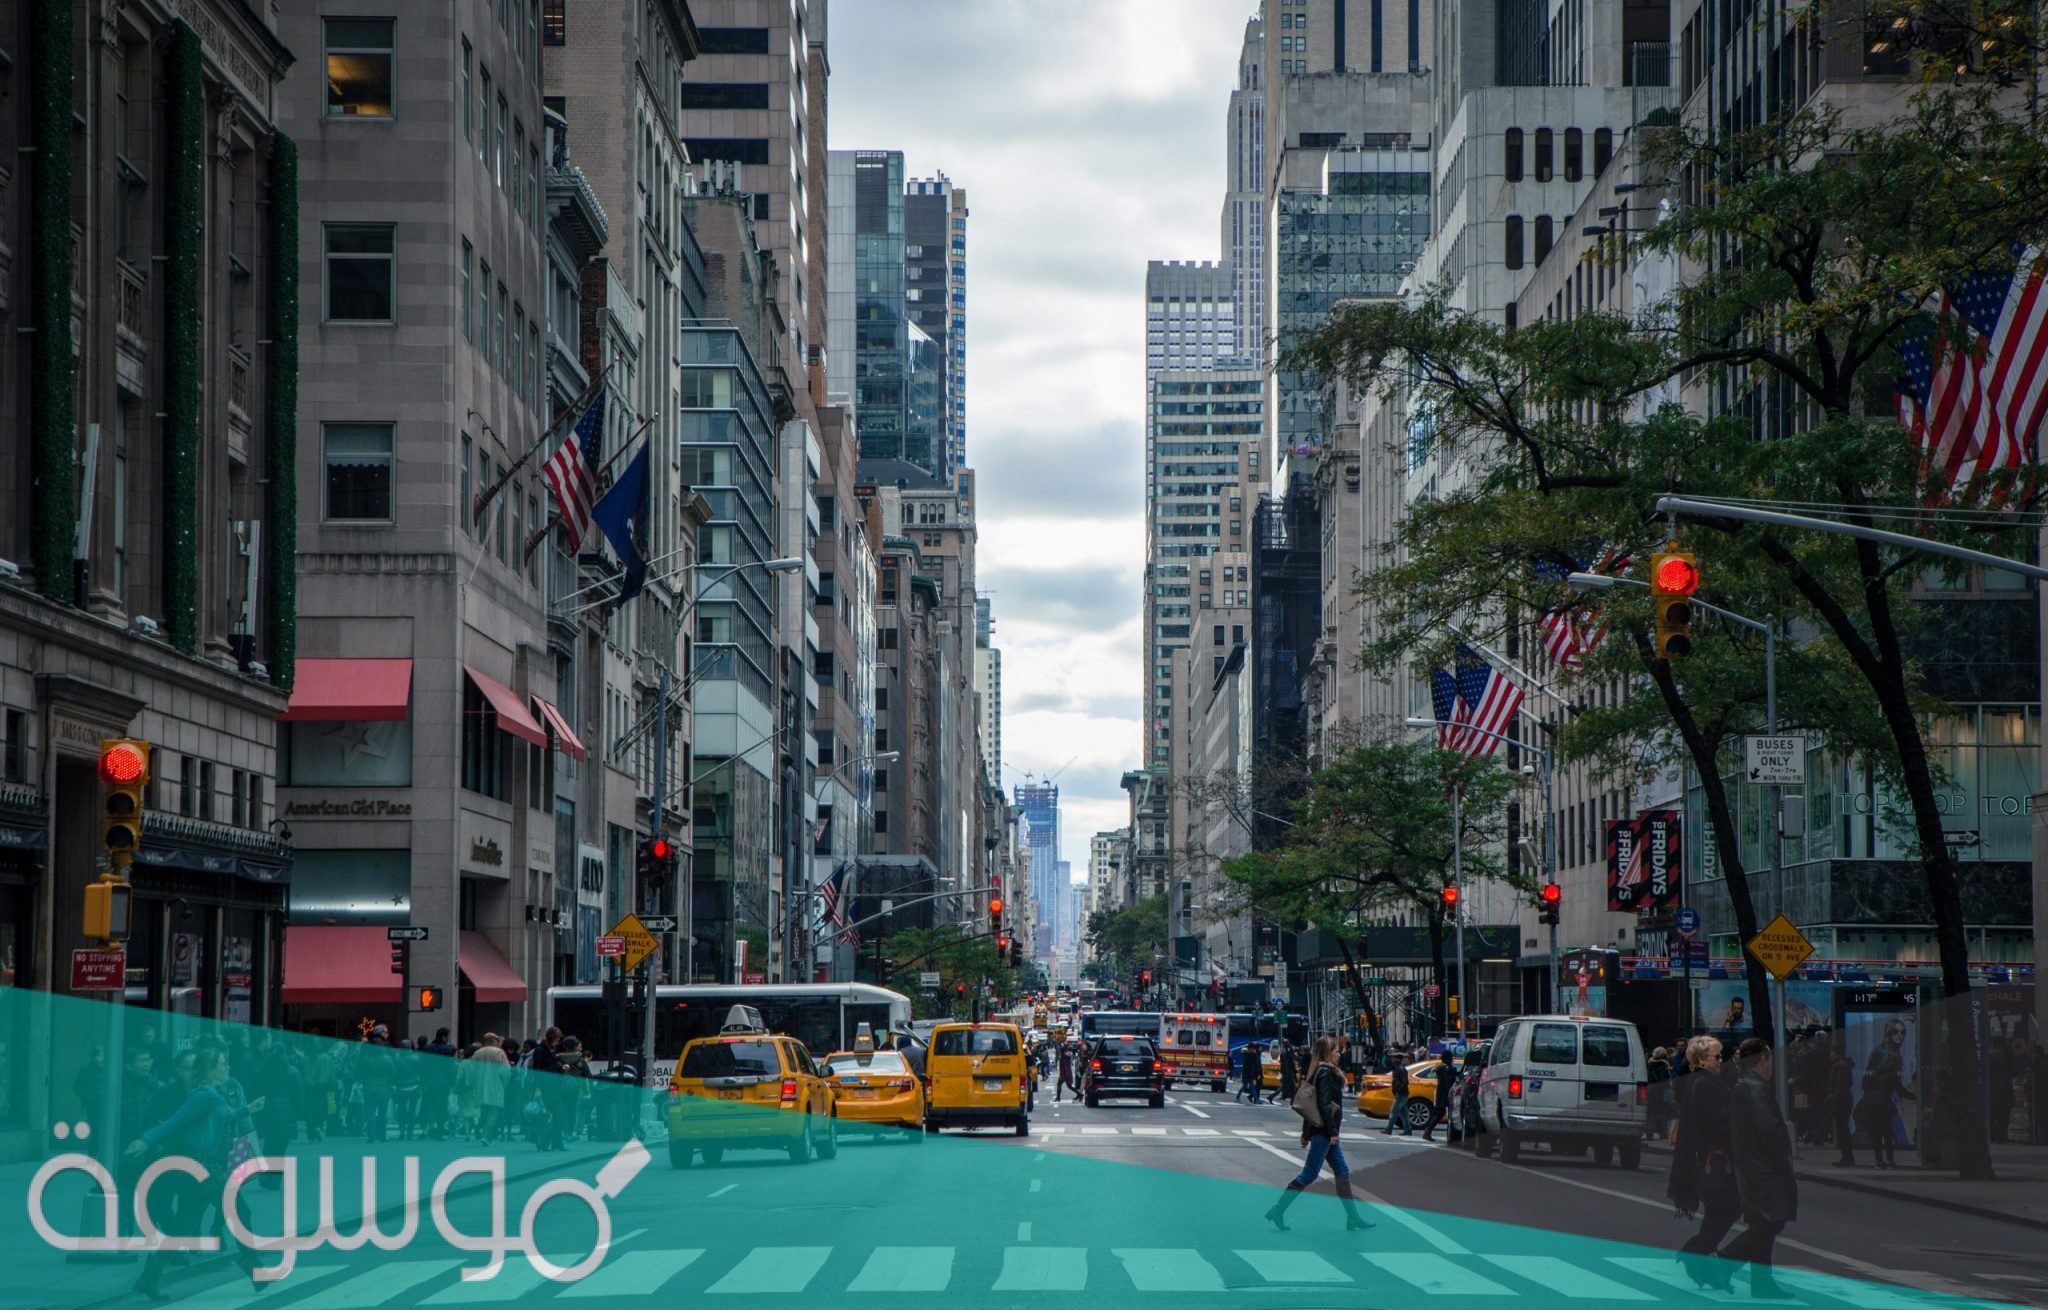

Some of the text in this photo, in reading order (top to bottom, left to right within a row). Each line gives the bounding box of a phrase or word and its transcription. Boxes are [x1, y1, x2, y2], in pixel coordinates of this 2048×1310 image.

[1757, 740, 1794, 750] BUSES
[1761, 756, 1790, 766] ONLY
[285, 798, 413, 816] American Girl Place
[1837, 793, 1967, 815] TOPSOP
[1652, 821, 1666, 829] TGI
[1618, 830, 1632, 838] TGI
[1959, 833, 1974, 841] WAY
[1652, 831, 1667, 896] FRIDAYS
[1618, 838, 1632, 901] FRIDYS
[1762, 934, 1801, 943] RECESSED
[1758, 943, 1805, 952] CROSSWALK
[76, 953, 123, 962] NO STOPPING
[81, 964, 117, 973] ANYTIME
